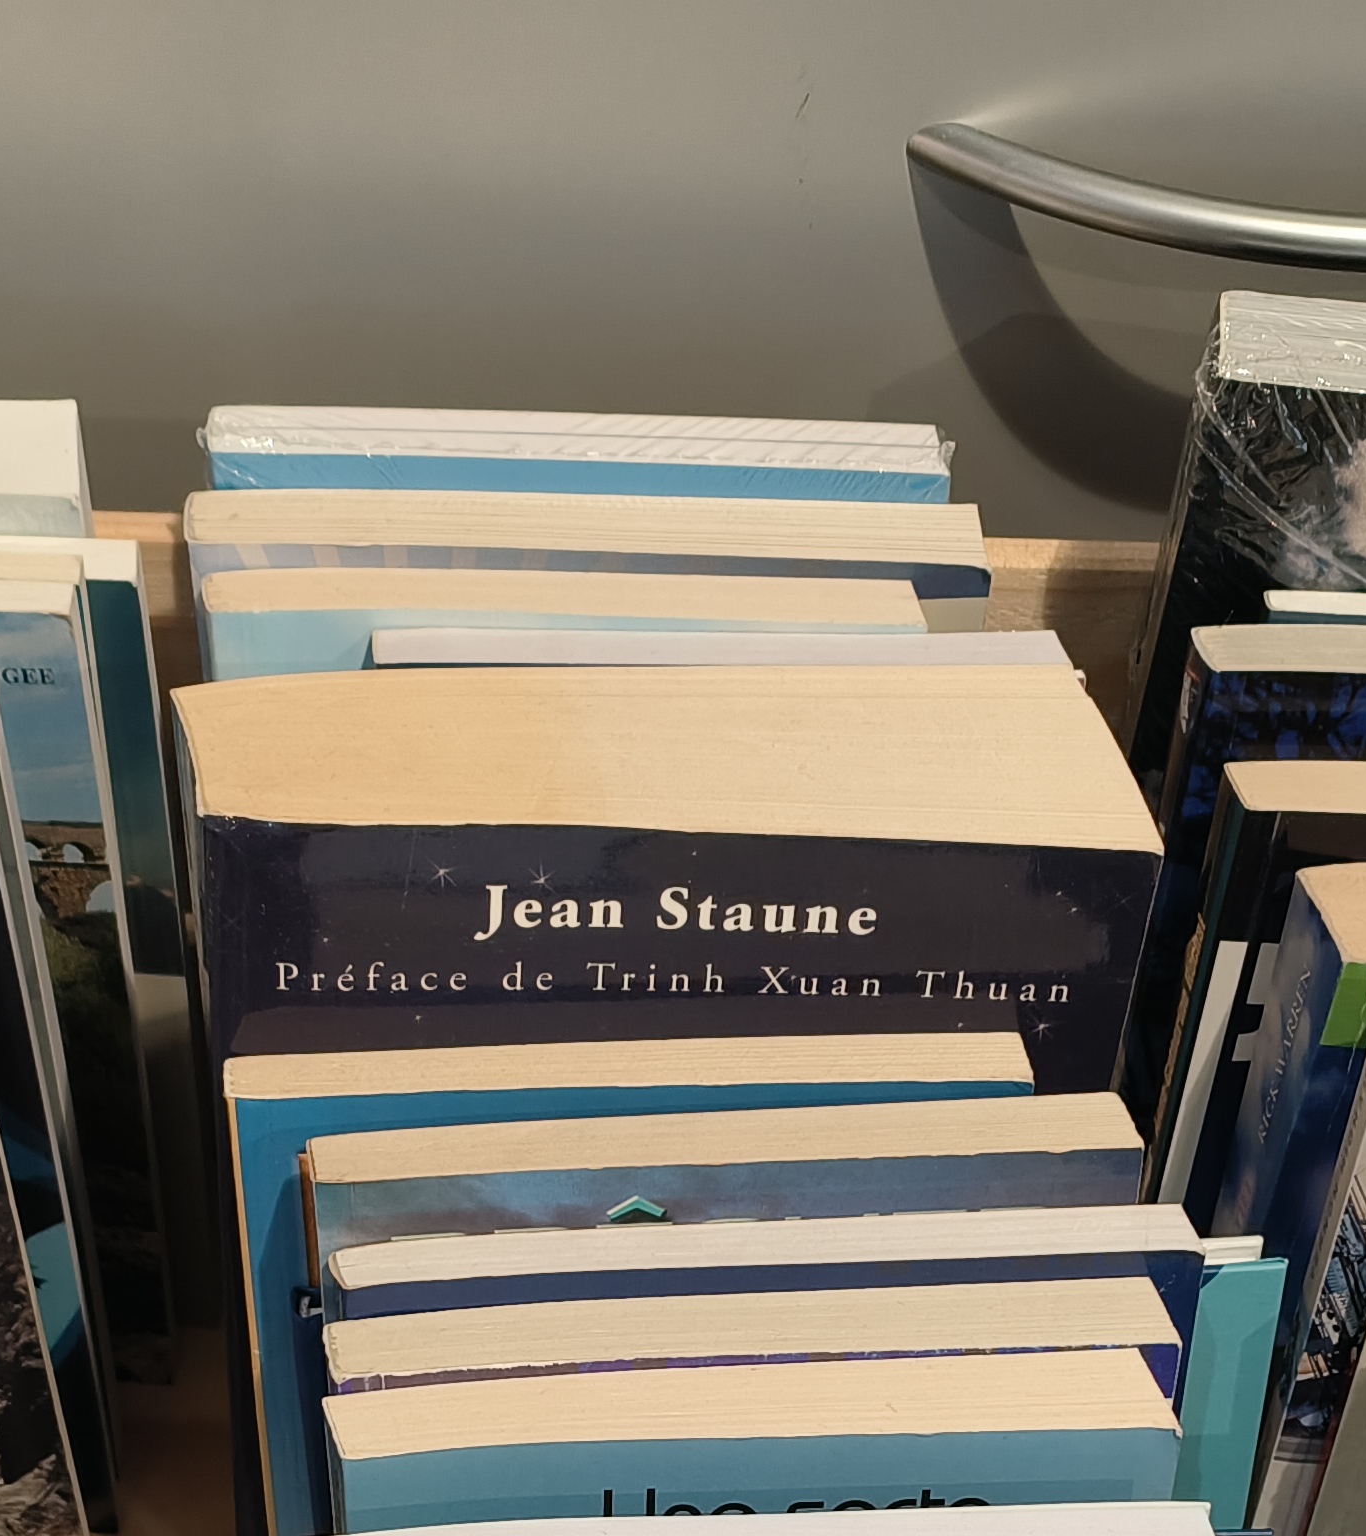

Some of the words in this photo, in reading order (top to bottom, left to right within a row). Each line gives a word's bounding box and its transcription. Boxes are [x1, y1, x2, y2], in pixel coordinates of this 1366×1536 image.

[1, 667, 56, 685] GEE
[474, 884, 626, 941] Jean
[655, 886, 880, 937] Staune
[275, 962, 469, 997] Préface
[501, 962, 555, 993] de
[586, 962, 727, 997] Trinh
[759, 965, 885, 1000] Xuan
[915, 970, 1072, 1006] Thuan
[1257, 1087, 1280, 1145] RICK
[1274, 963, 1312, 1076] WARREN
